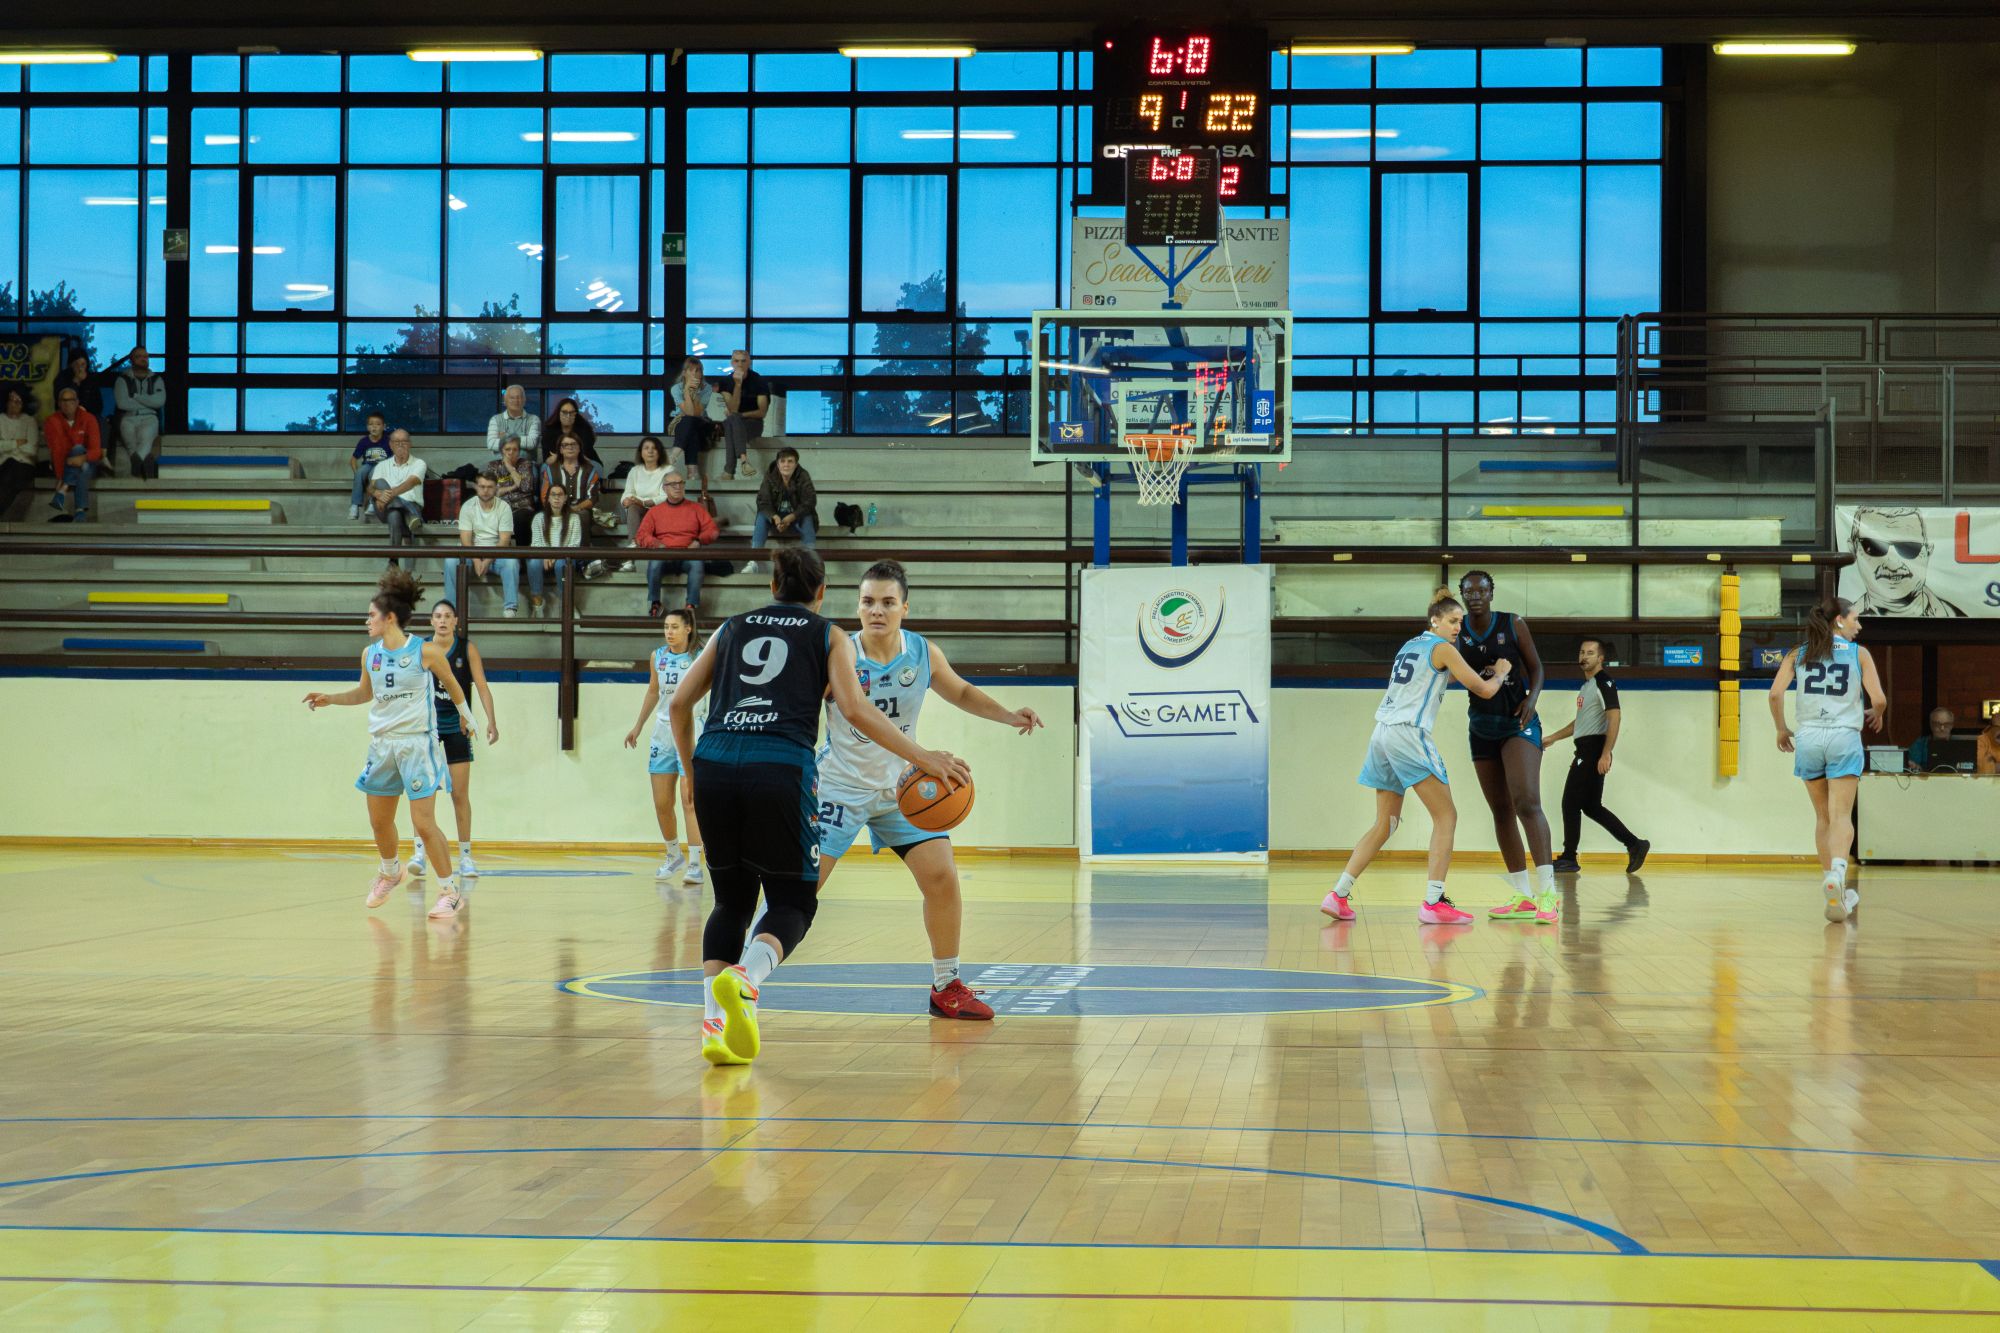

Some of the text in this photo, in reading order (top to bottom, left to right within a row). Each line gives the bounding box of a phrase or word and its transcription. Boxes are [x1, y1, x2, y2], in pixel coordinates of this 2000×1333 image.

[1140, 95, 1163, 131] 9
[1206, 94, 1256, 131] 22
[1161, 149, 1181, 157] PMF
[1254, 418, 1272, 426] FIP
[745, 615, 809, 627] CUPIDO
[739, 636, 789, 685] 9
[385, 673, 394, 688] 9
[665, 672, 678, 685] 13
[1804, 662, 1849, 697] 23
[1157, 702, 1241, 723] GAMET
[818, 801, 844, 828] 21
[810, 844, 820, 868] 9
